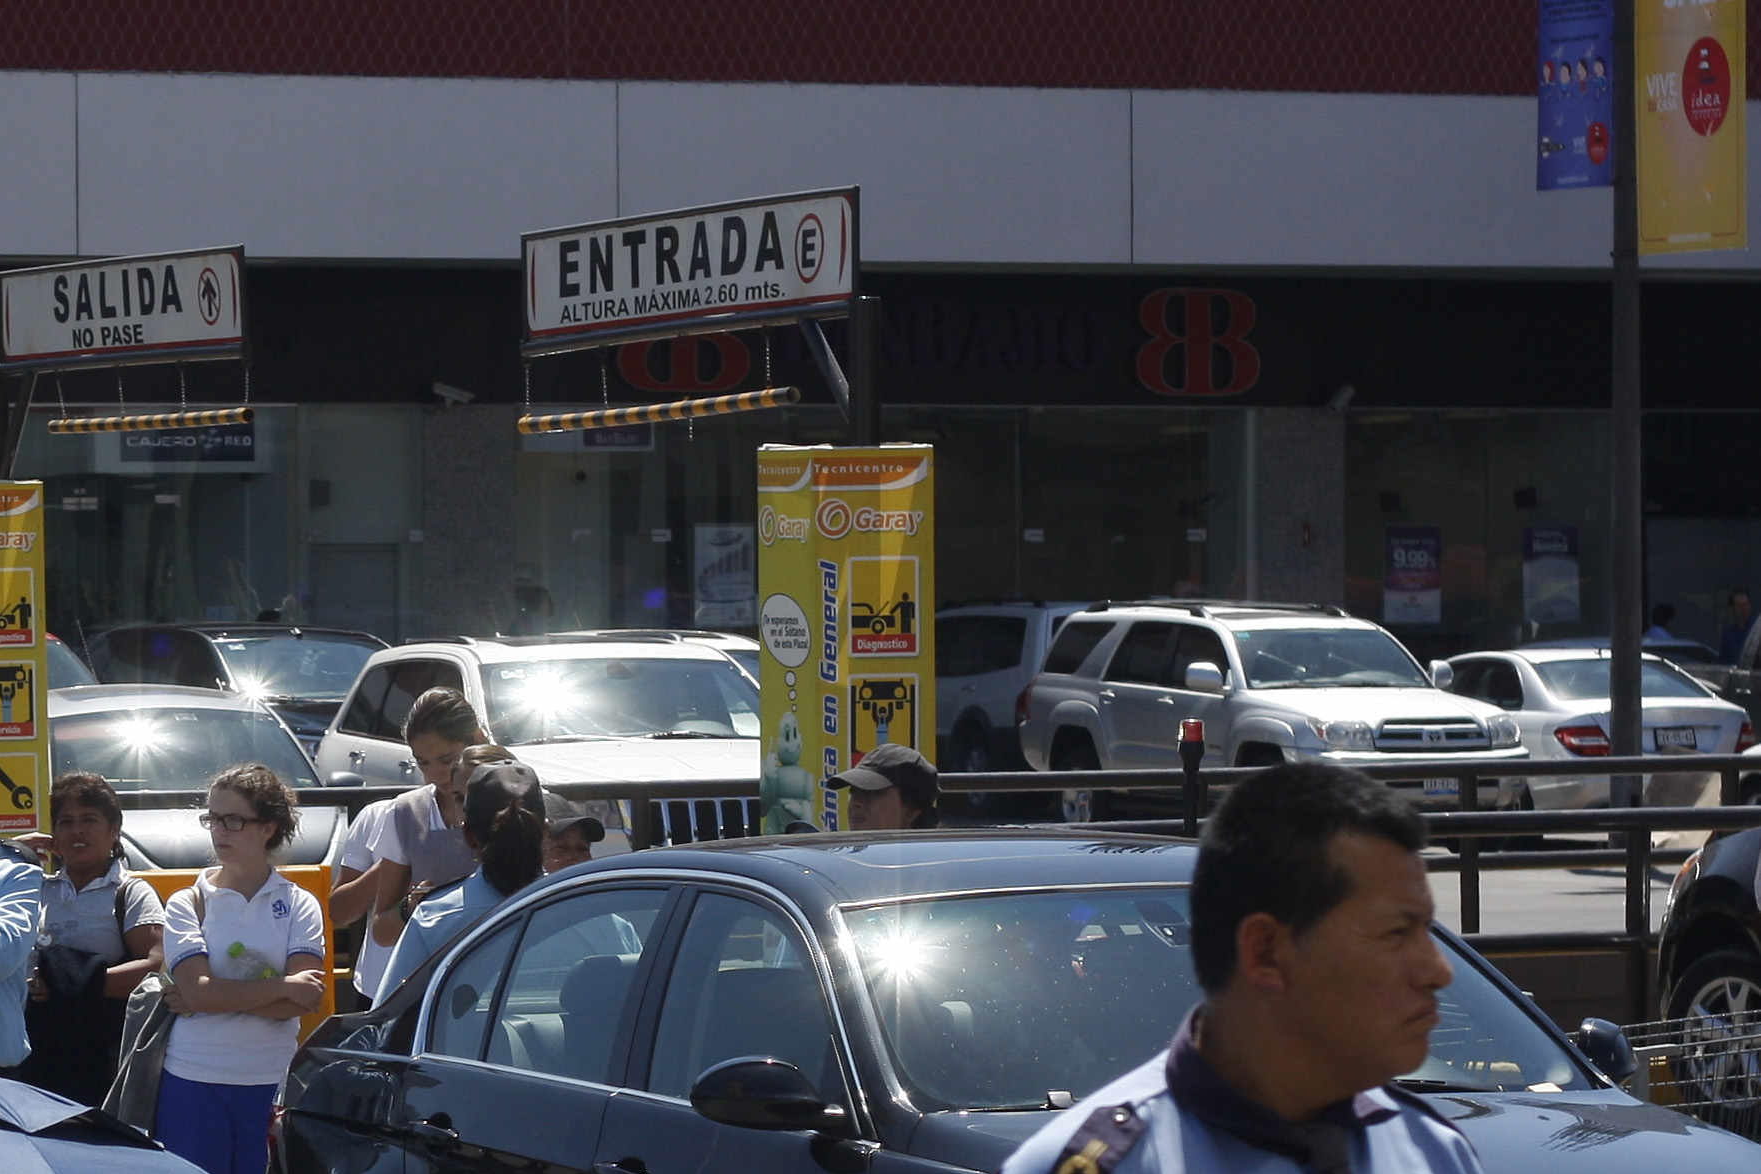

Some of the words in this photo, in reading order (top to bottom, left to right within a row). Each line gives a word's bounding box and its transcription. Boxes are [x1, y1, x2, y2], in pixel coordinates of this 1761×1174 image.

[559, 210, 785, 299] ENTRADA
[801, 228, 817, 269] E
[53, 264, 184, 324] SALIDA
[560, 300, 629, 325] ALTURA
[634, 288, 701, 315] MÁXIMA
[704, 283, 739, 306] 2.60
[745, 280, 786, 301] mts.
[72, 328, 94, 348] NO
[101, 323, 144, 347] PASE
[814, 463, 904, 474] Tecnicentro
[778, 516, 809, 542] Garay
[855, 508, 923, 535] Garay
[820, 560, 838, 683] General
[857, 637, 908, 651] Diagnostico
[824, 696, 838, 734] en
